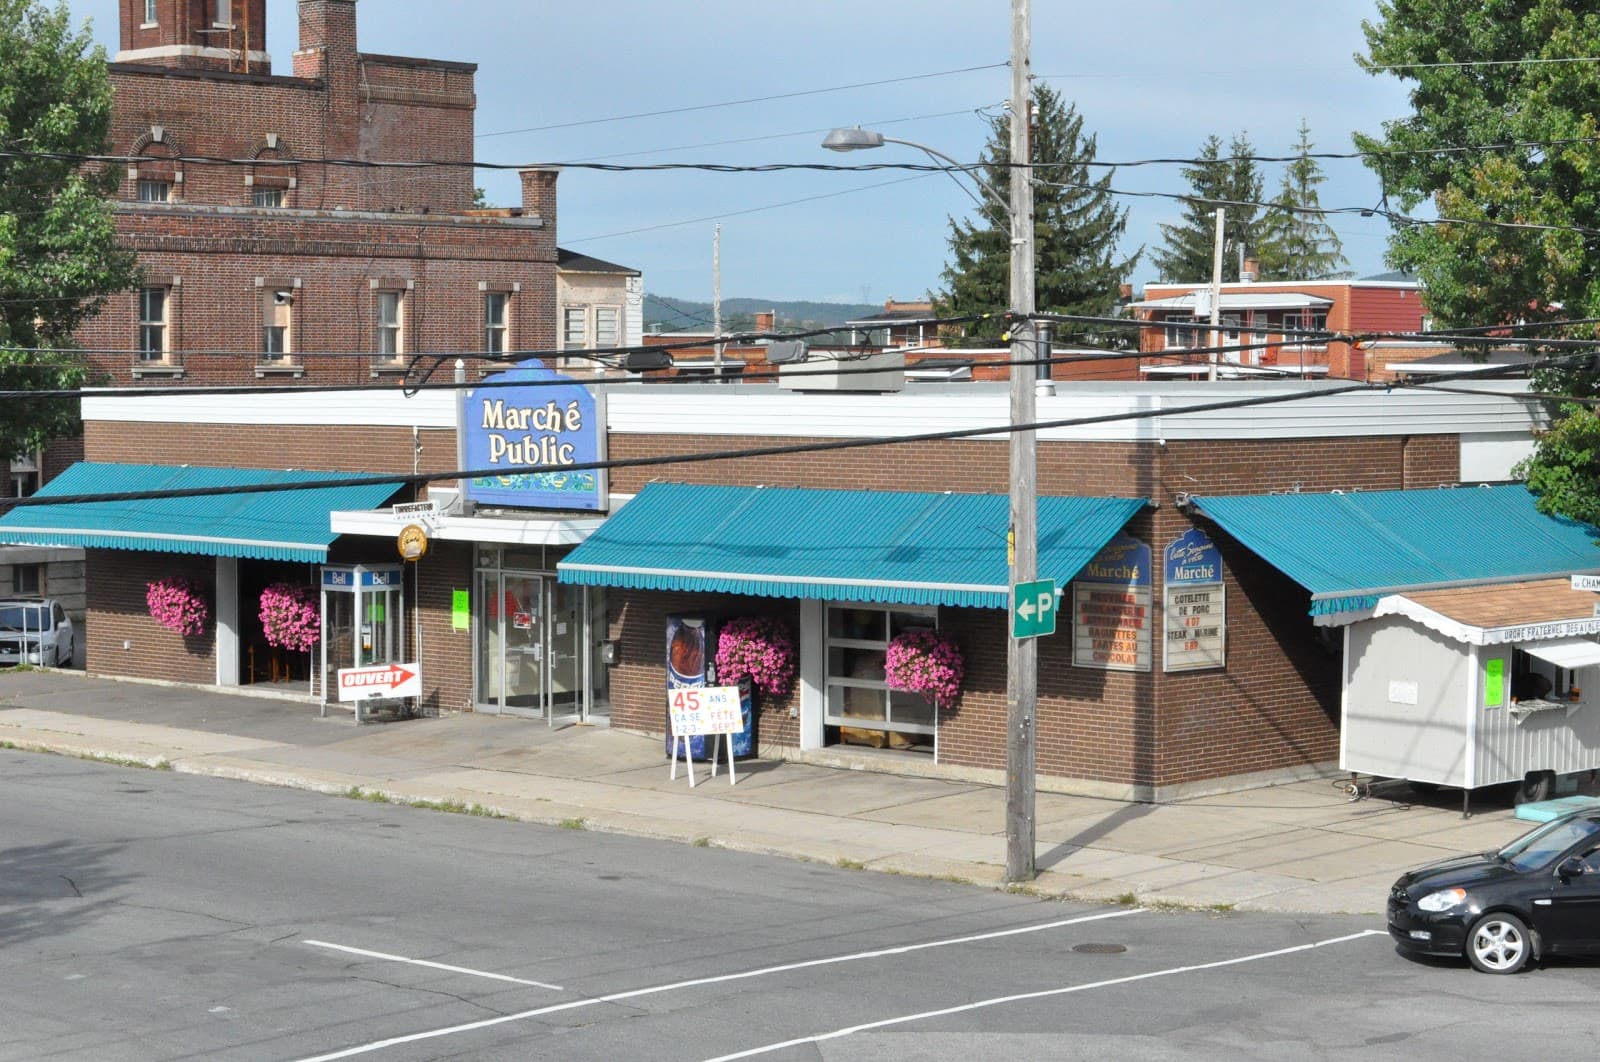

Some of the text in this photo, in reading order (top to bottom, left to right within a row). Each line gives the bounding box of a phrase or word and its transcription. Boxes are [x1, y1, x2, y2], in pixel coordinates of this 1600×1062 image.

[481, 399, 582, 433] Marché
[488, 433, 575, 466] Public
[332, 571, 346, 585] Bell
[372, 571, 390, 585] Bell
[1088, 563, 1139, 580] Marché
[1174, 564, 1215, 580] Marché
[1037, 592, 1054, 624] P
[344, 670, 403, 687] OUVERT
[673, 691, 727, 712] 45 ANS
